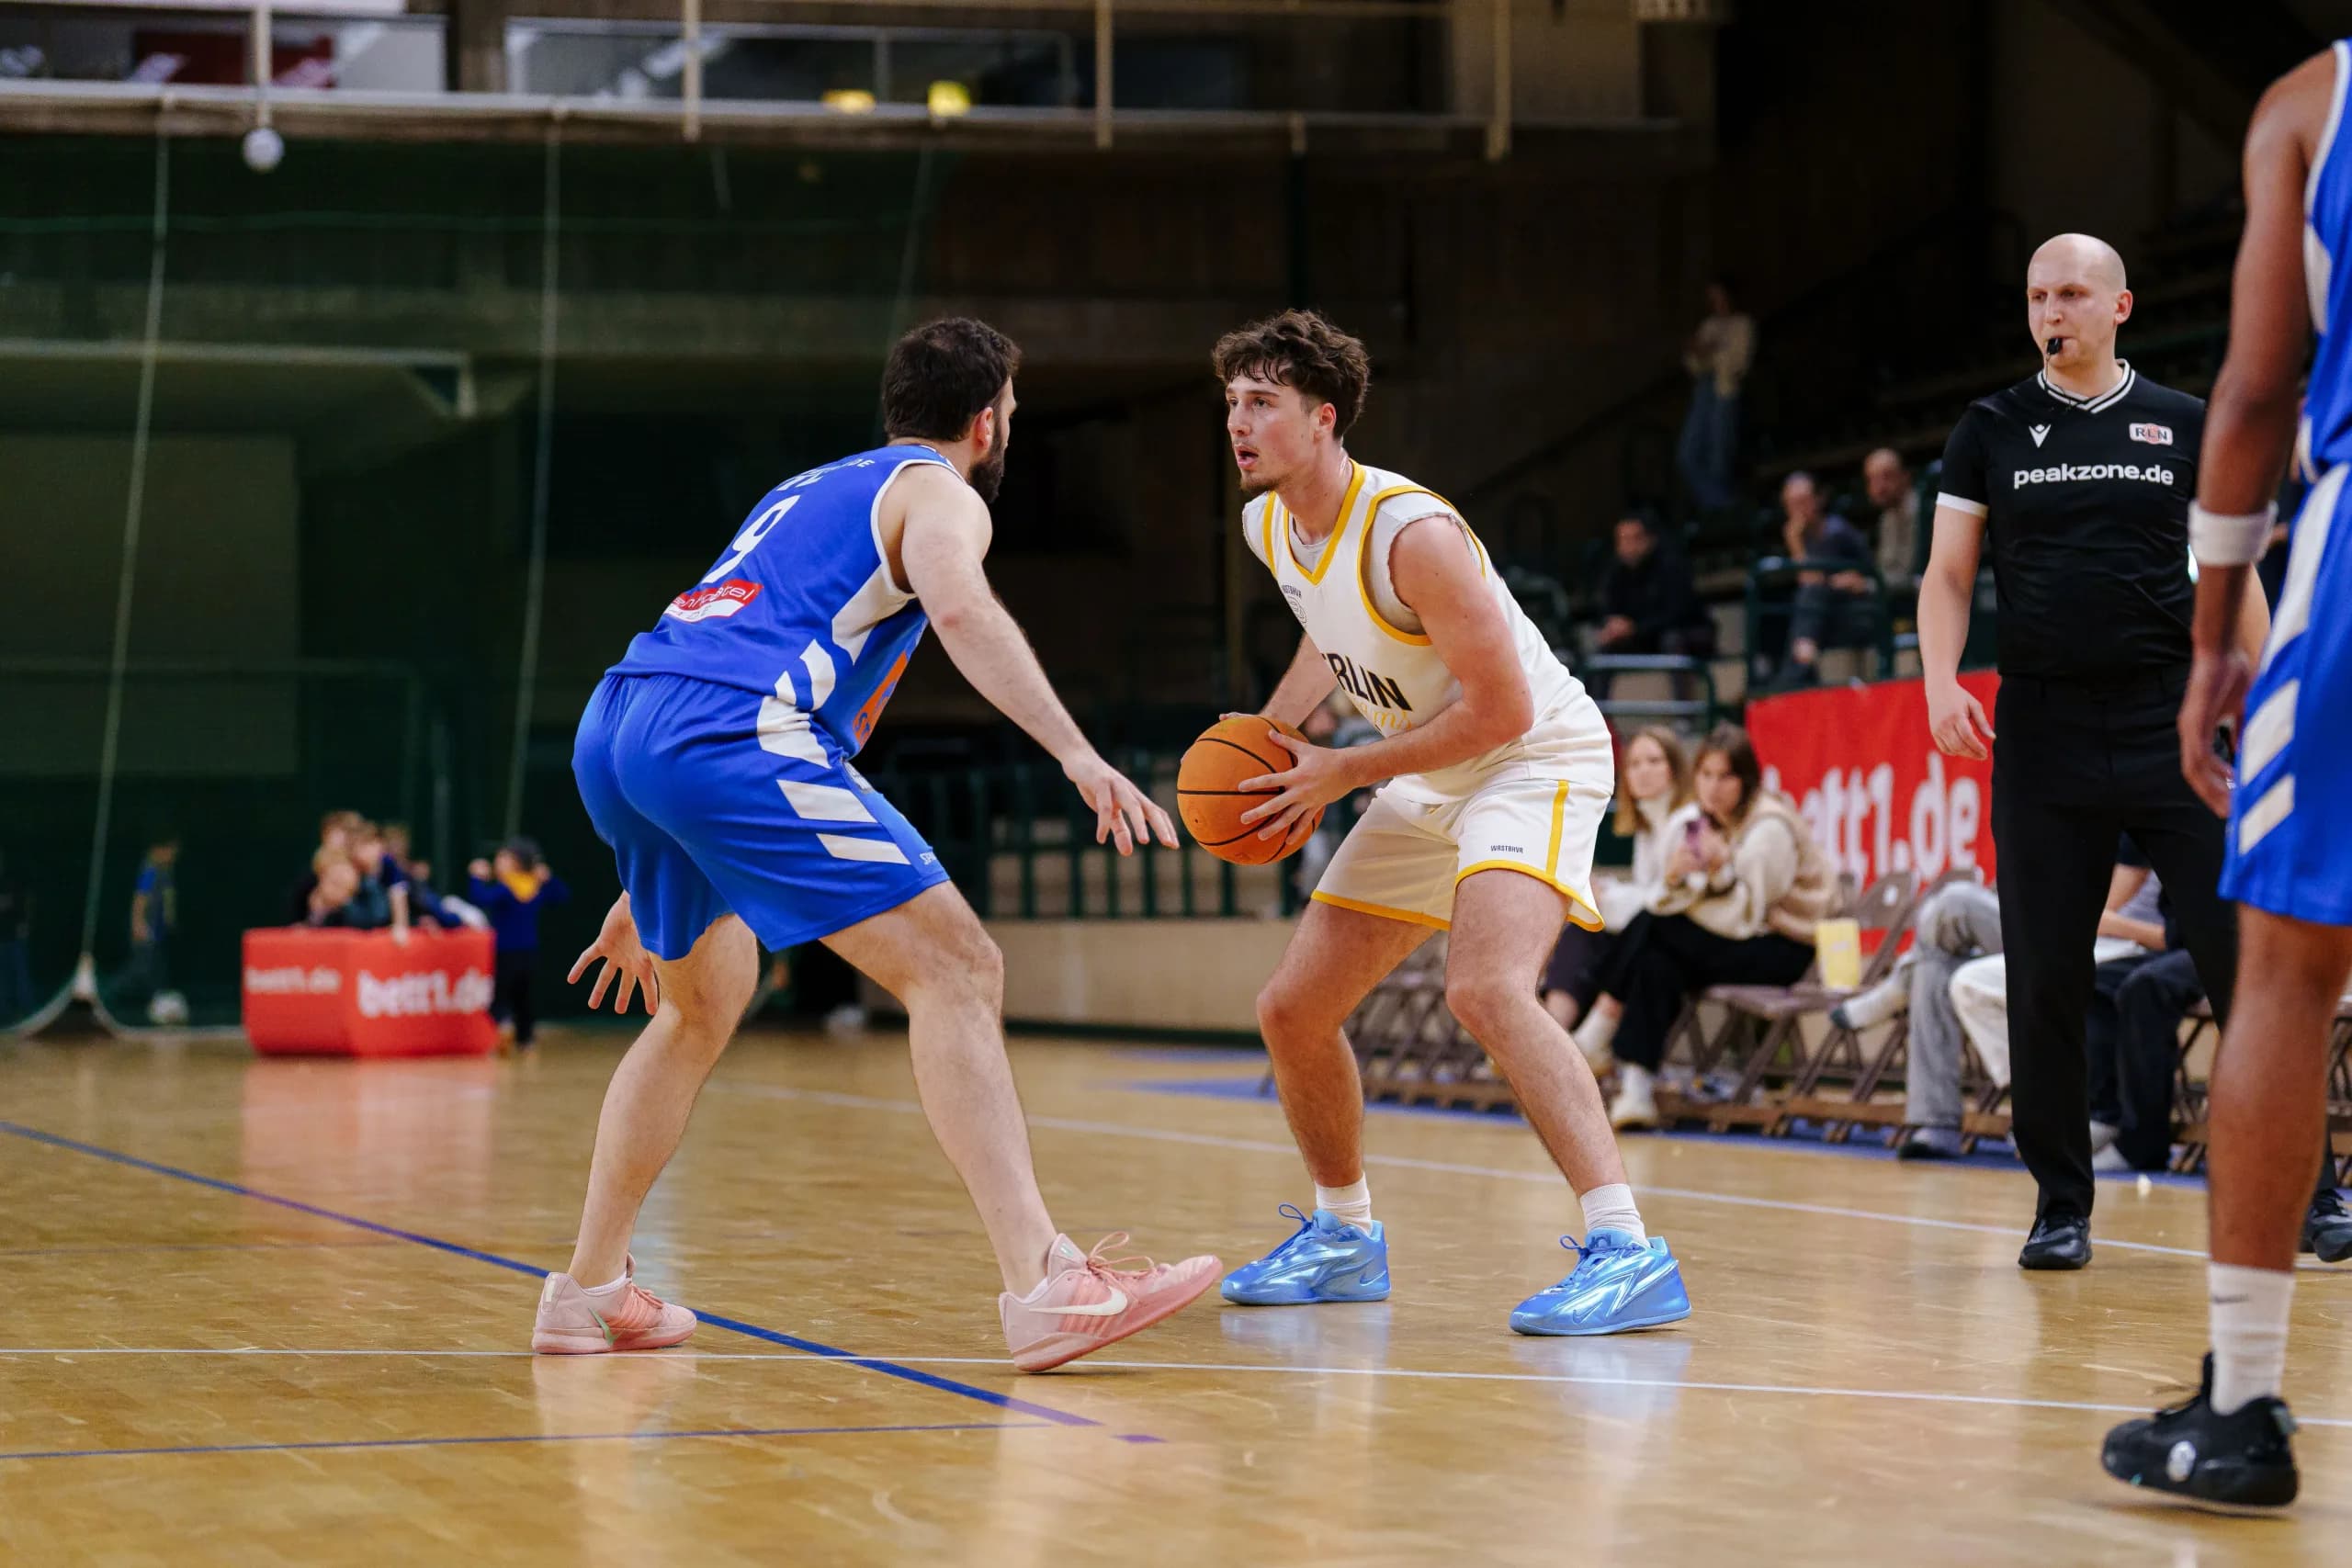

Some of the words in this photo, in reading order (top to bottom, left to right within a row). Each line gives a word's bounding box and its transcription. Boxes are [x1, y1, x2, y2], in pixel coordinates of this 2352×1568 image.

[2135, 426, 2168, 441] RLN
[2013, 463, 2174, 490] peakzone.de
[701, 494, 801, 584] 9
[1321, 652, 1413, 712] RLIN
[1763, 750, 1981, 882] ett1.de
